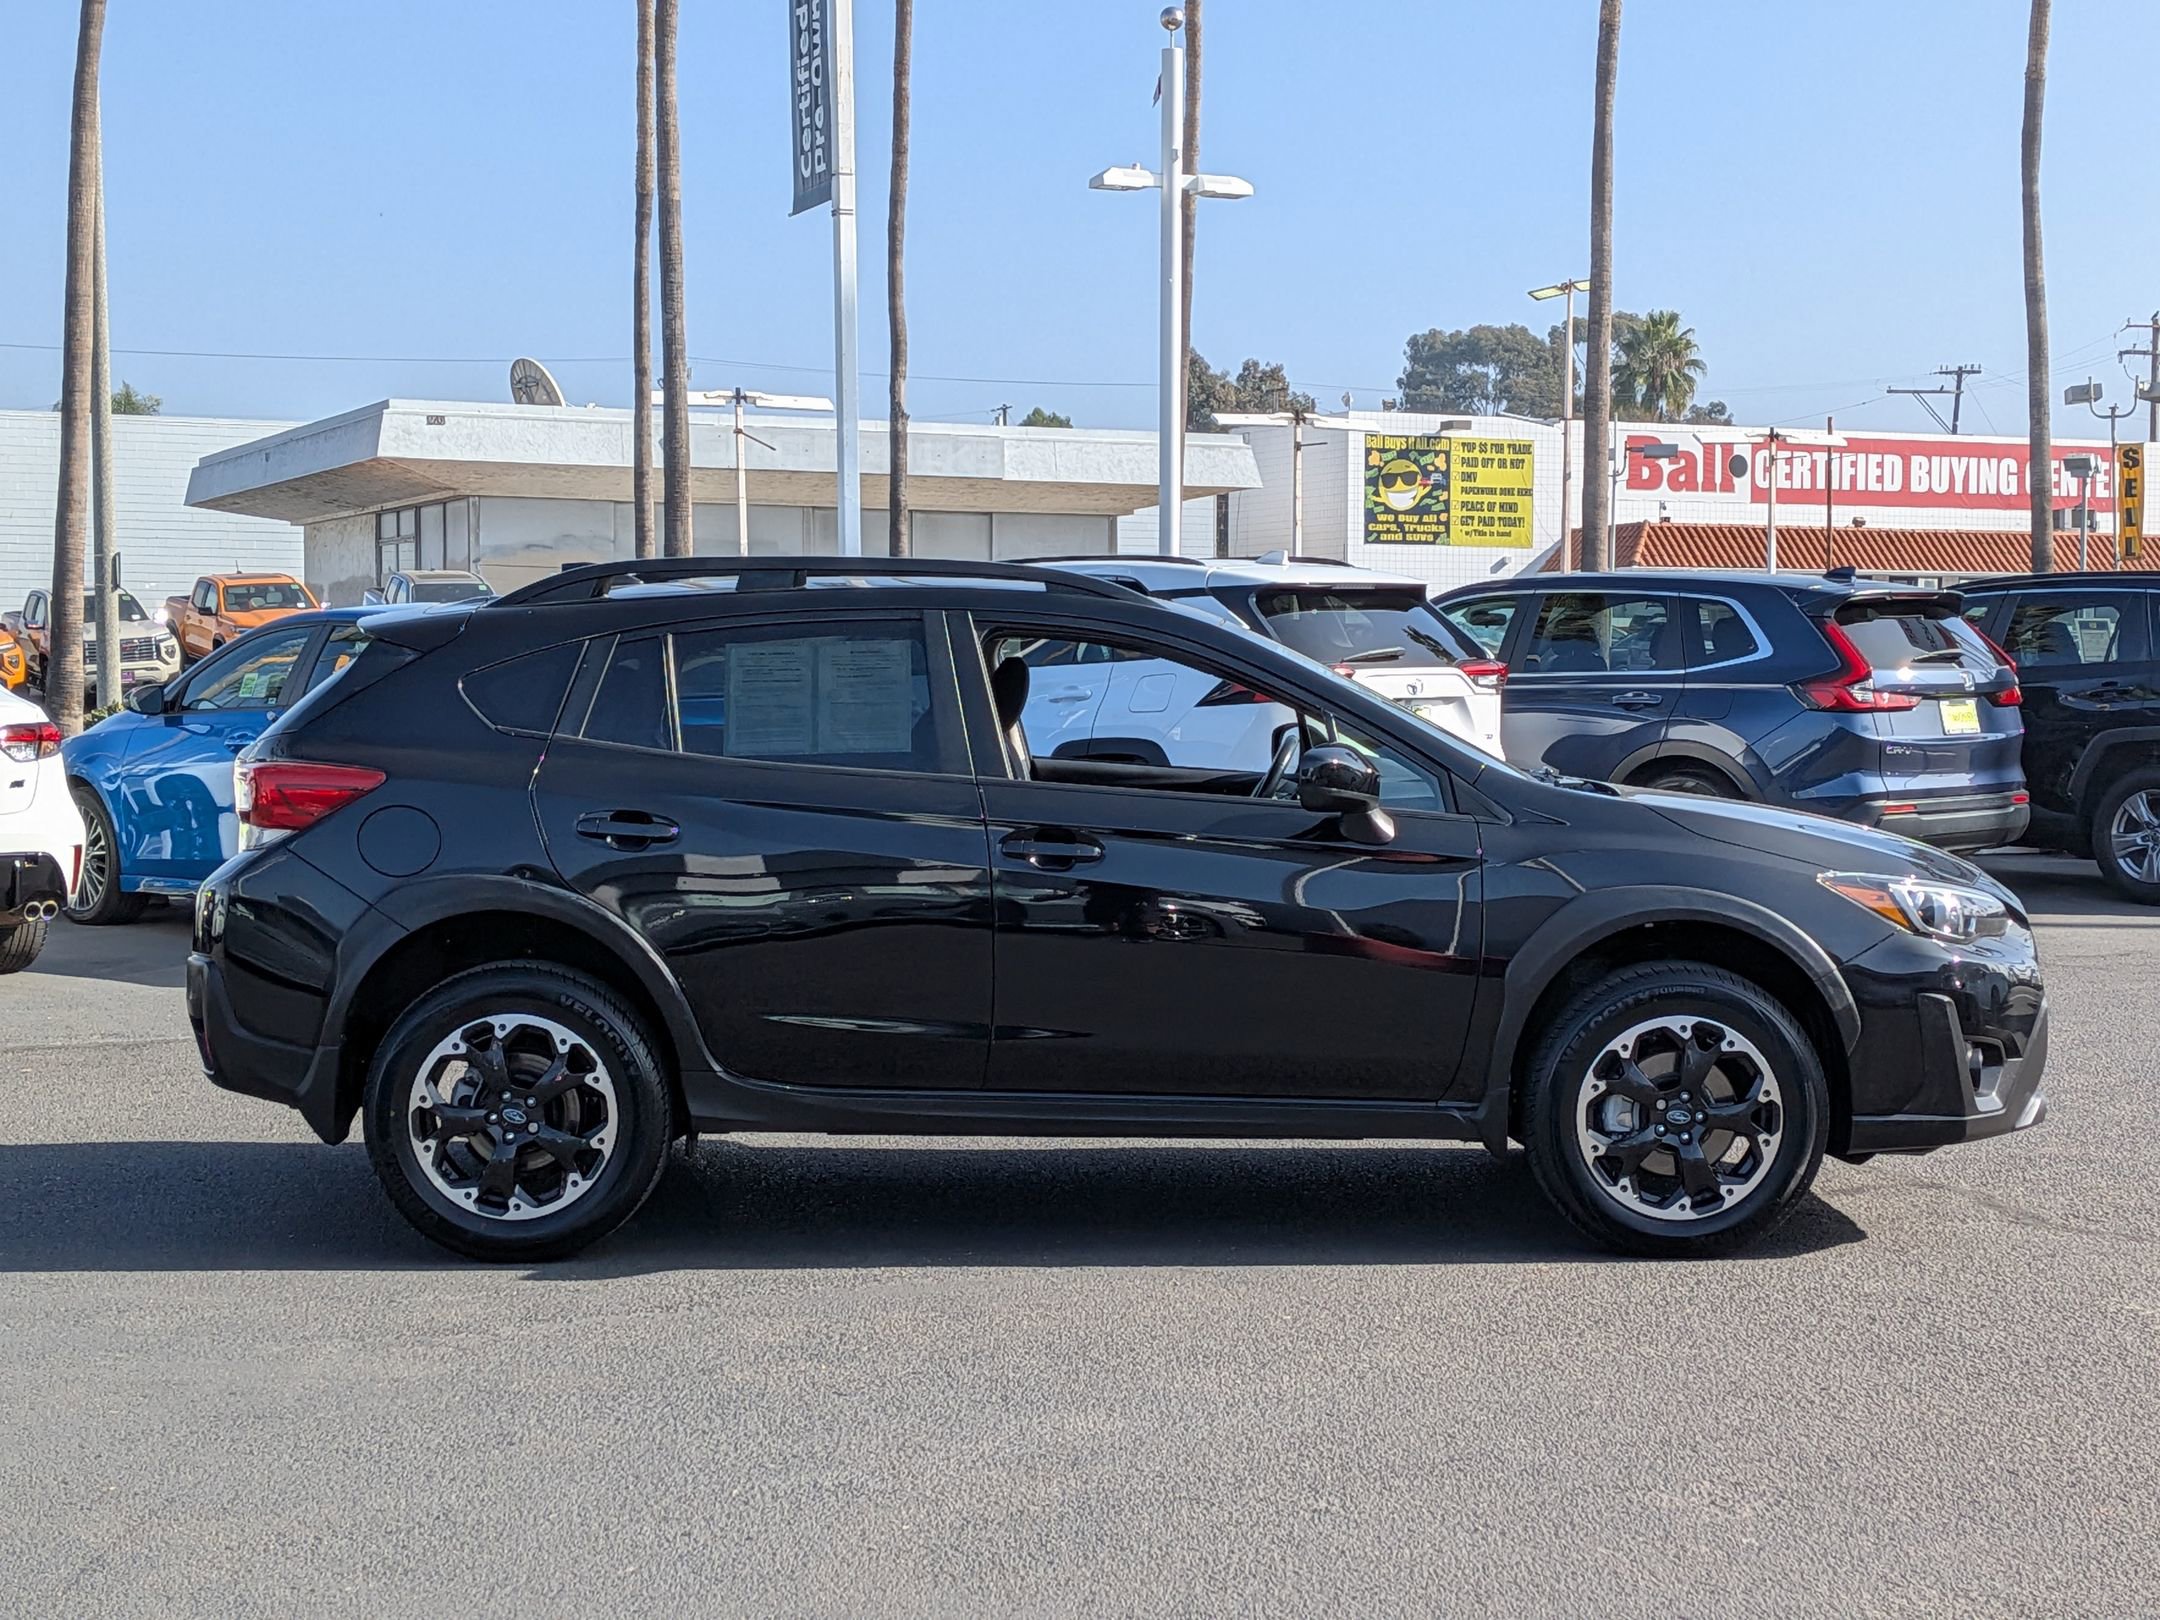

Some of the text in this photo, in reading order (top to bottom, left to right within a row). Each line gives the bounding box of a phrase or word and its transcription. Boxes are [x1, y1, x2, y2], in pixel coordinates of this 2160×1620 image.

[795, 3, 812, 178] Certified
[1366, 434, 1383, 449] Ball
[1384, 436, 1407, 450] Buys
[1461, 442, 1533, 455] TOP $$ FOR TRADE
[1461, 457, 1526, 470] PAID OFF OR NOT
[1626, 435, 1736, 493] Ball
[1754, 449, 1904, 492] CERTIFIED
[1910, 455, 2019, 496] BUYING
[1461, 471, 1478, 483] DMV
[1460, 486, 1534, 497] PAPERWORK DONE HERE
[1460, 501, 1519, 513] PEACE OF MIND
[2122, 447, 2140, 557] $ELL
[1398, 514, 1420, 523] Buy
[1422, 514, 1438, 523] All
[1460, 515, 1525, 528] GET PAID TODAY!
[1404, 524, 1446, 532] Trucks
[1496, 530, 1512, 538] hand
[1380, 533, 1403, 541] and
